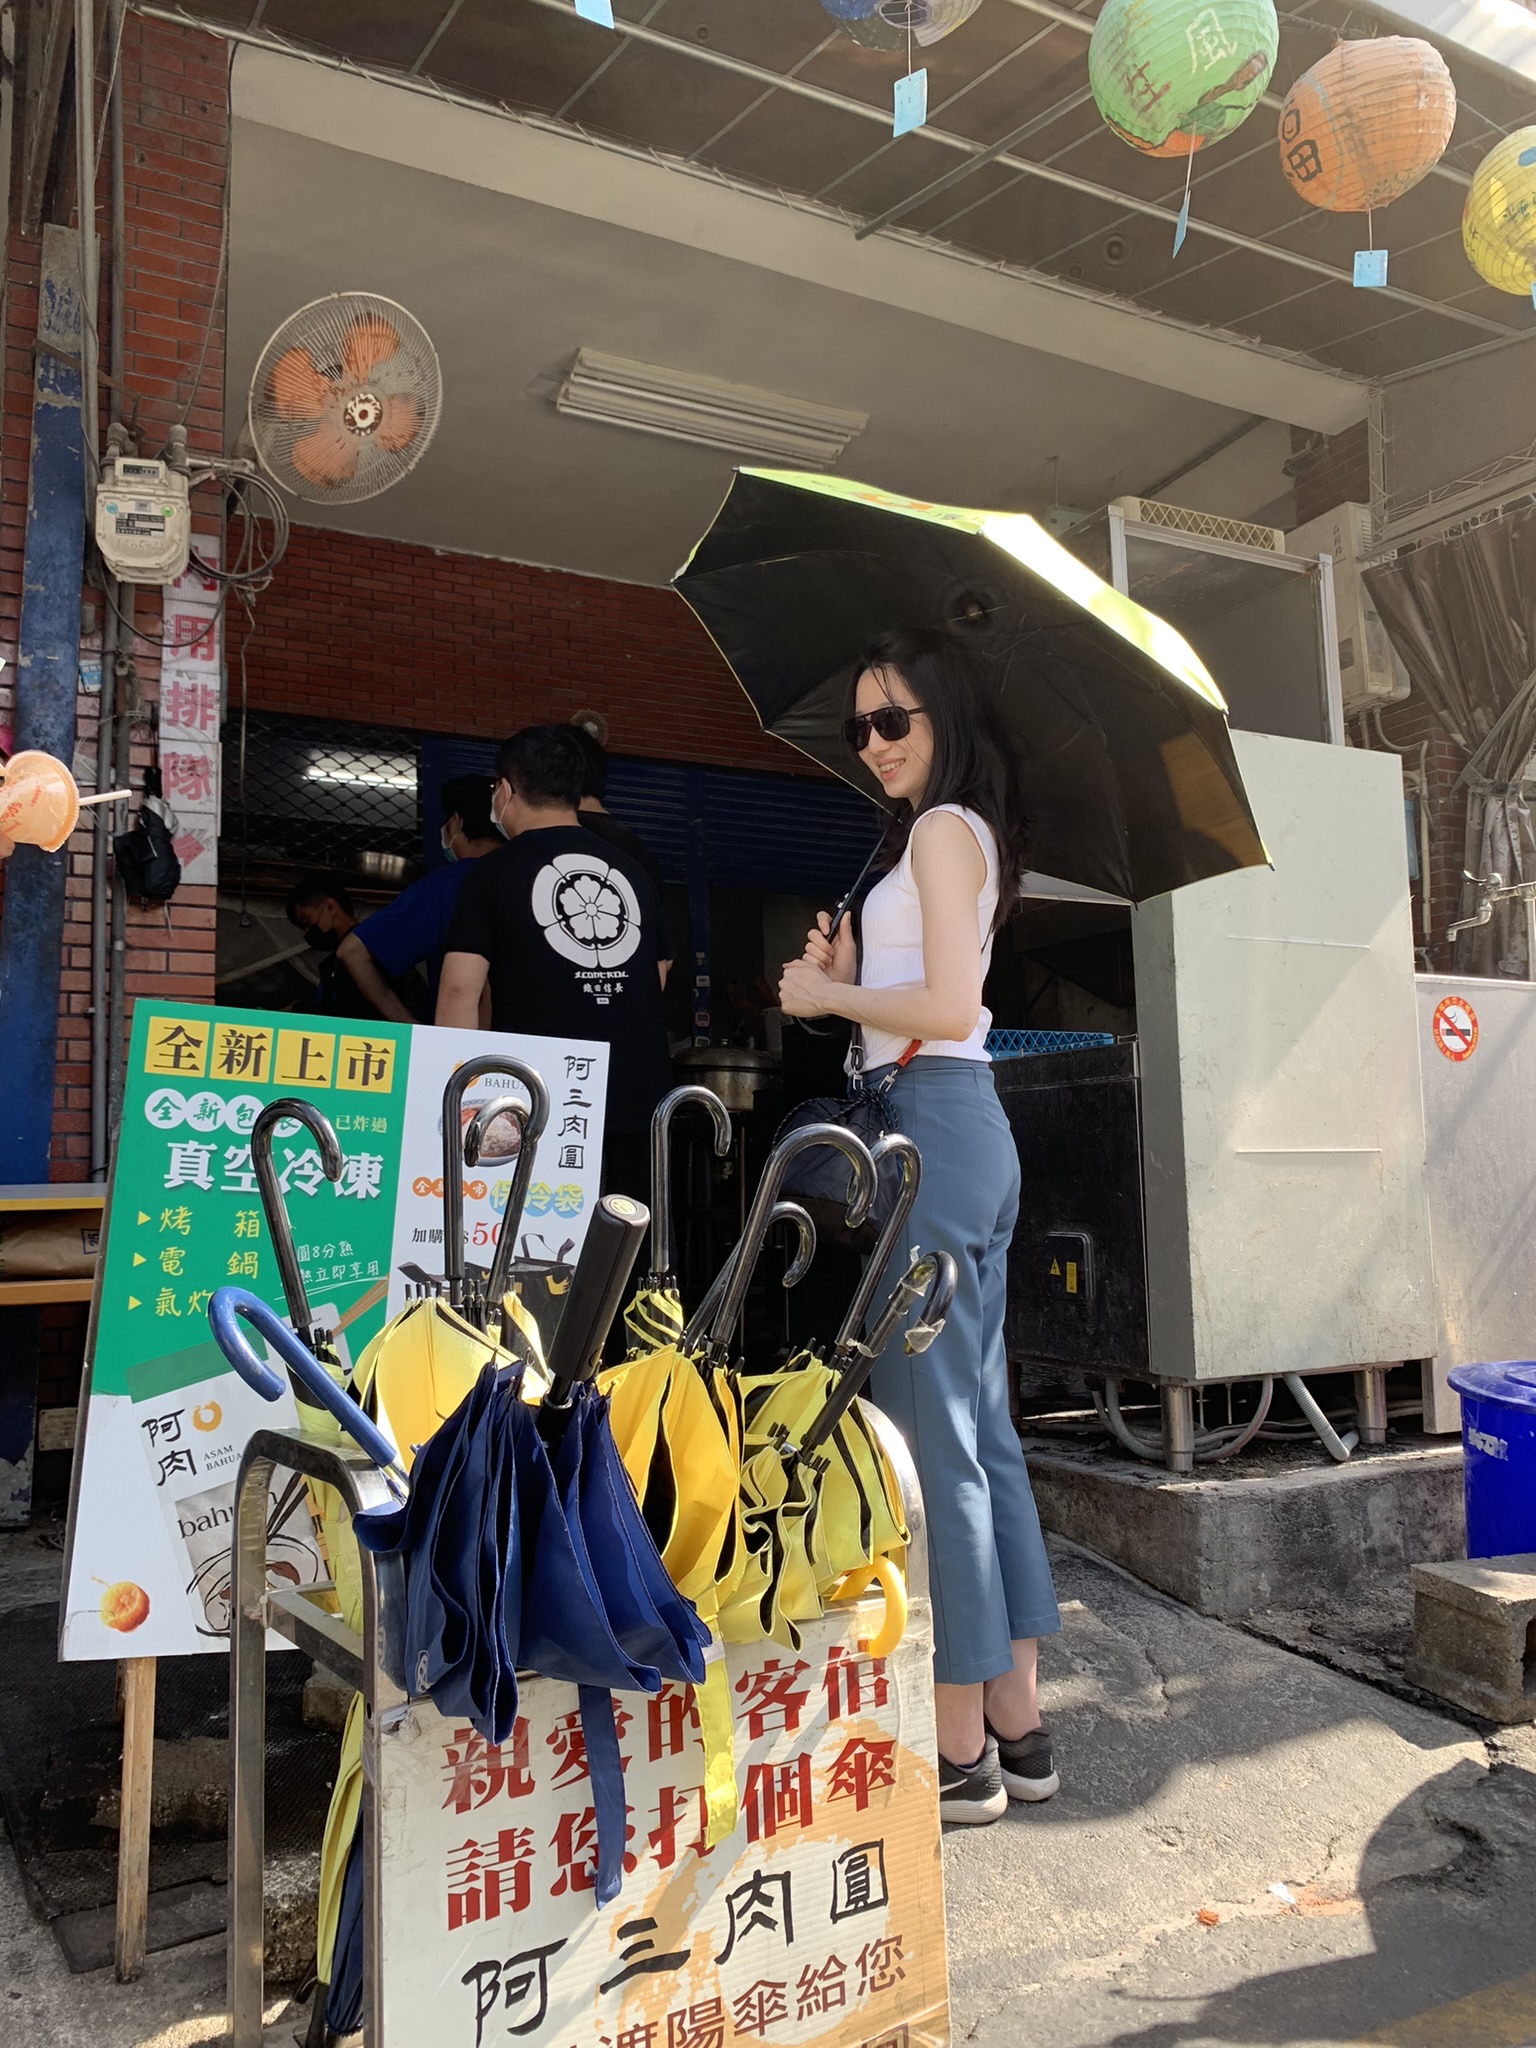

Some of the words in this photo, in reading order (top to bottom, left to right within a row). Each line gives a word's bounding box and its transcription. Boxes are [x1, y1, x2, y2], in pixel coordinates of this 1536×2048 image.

[1185, 7, 1238, 77] 風
[152, 1024, 390, 1088] 全新上市
[335, 1114, 388, 1133] 已炸過
[557, 1055, 597, 1170] 阿三肉圓
[164, 1140, 384, 1199] 真空冷凍
[491, 1179, 584, 1212] 保冷袋
[203, 1444, 234, 1461] ASAM
[445, 1737, 898, 1932] 請您打個傘
[461, 1838, 889, 2048] 阿三肉圓
